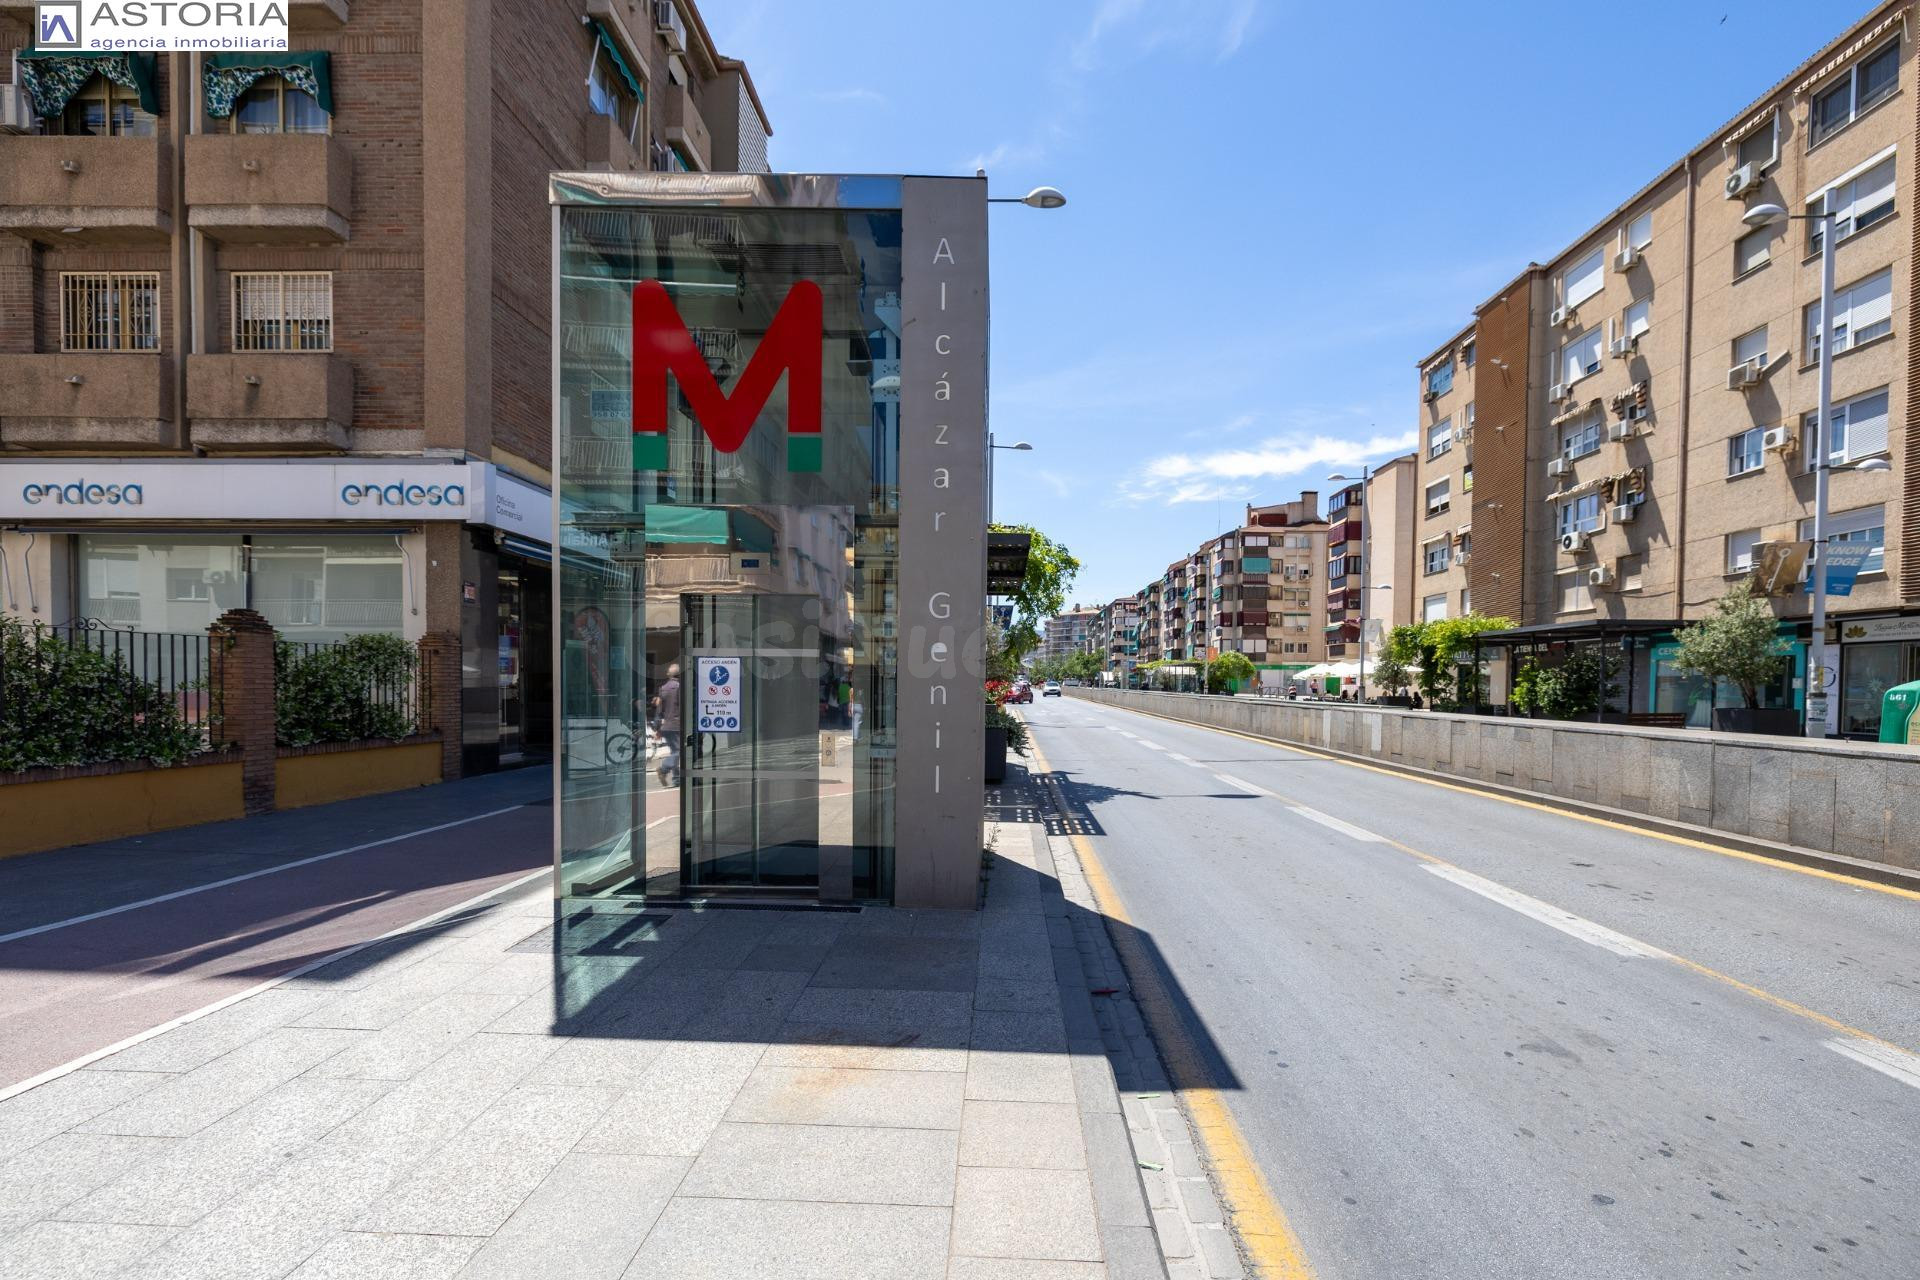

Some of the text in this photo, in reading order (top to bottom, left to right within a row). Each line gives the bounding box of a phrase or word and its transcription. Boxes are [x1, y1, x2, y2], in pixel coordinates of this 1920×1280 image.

[632, 278, 823, 472] M
[22, 477, 143, 505] endesa
[341, 477, 465, 506] endesa
[928, 237, 955, 794] Alcázar Genil
